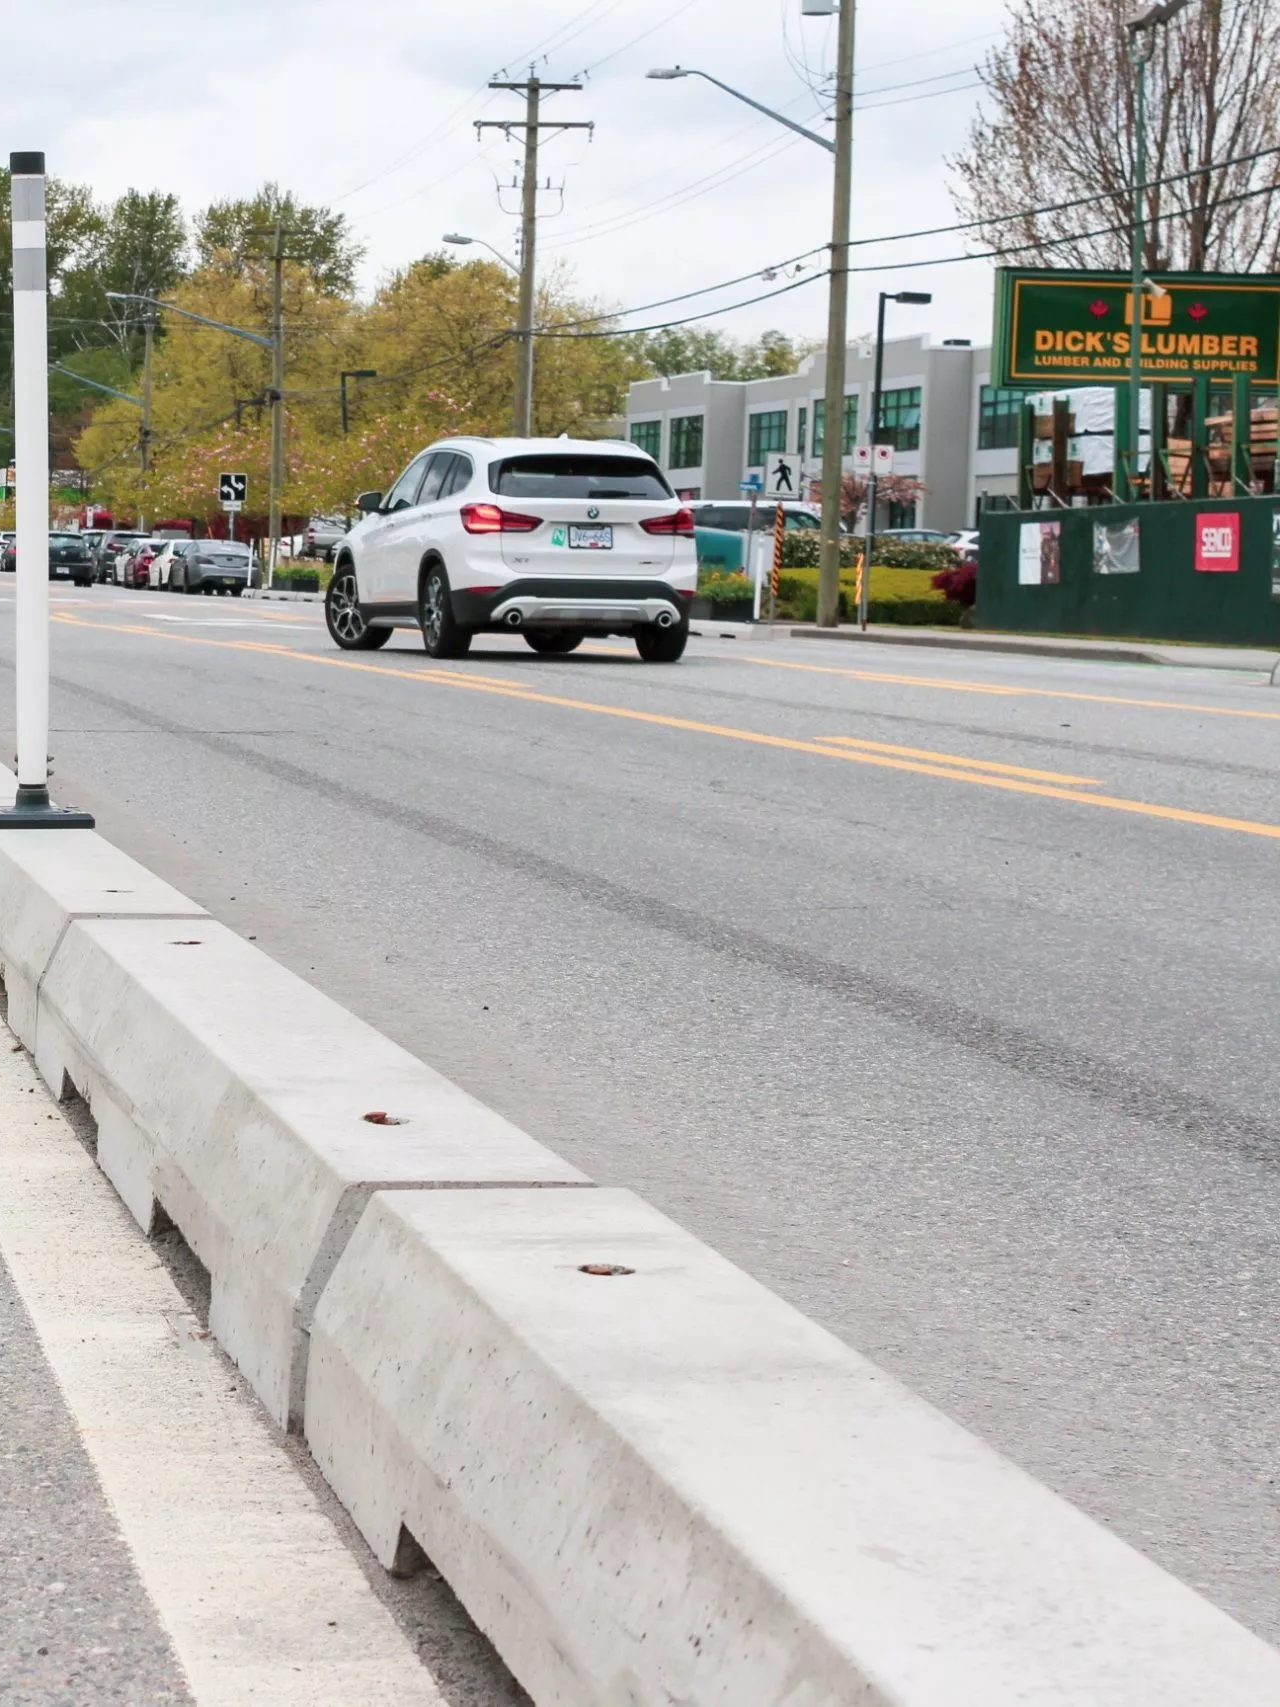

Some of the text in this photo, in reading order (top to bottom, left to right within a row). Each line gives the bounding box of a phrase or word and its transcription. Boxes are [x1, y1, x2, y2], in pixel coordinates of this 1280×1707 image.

[1035, 330, 1258, 357] DICK'S LUMBER
[1034, 355, 1258, 371] LUMBER AND BILDING SUPPLIES
